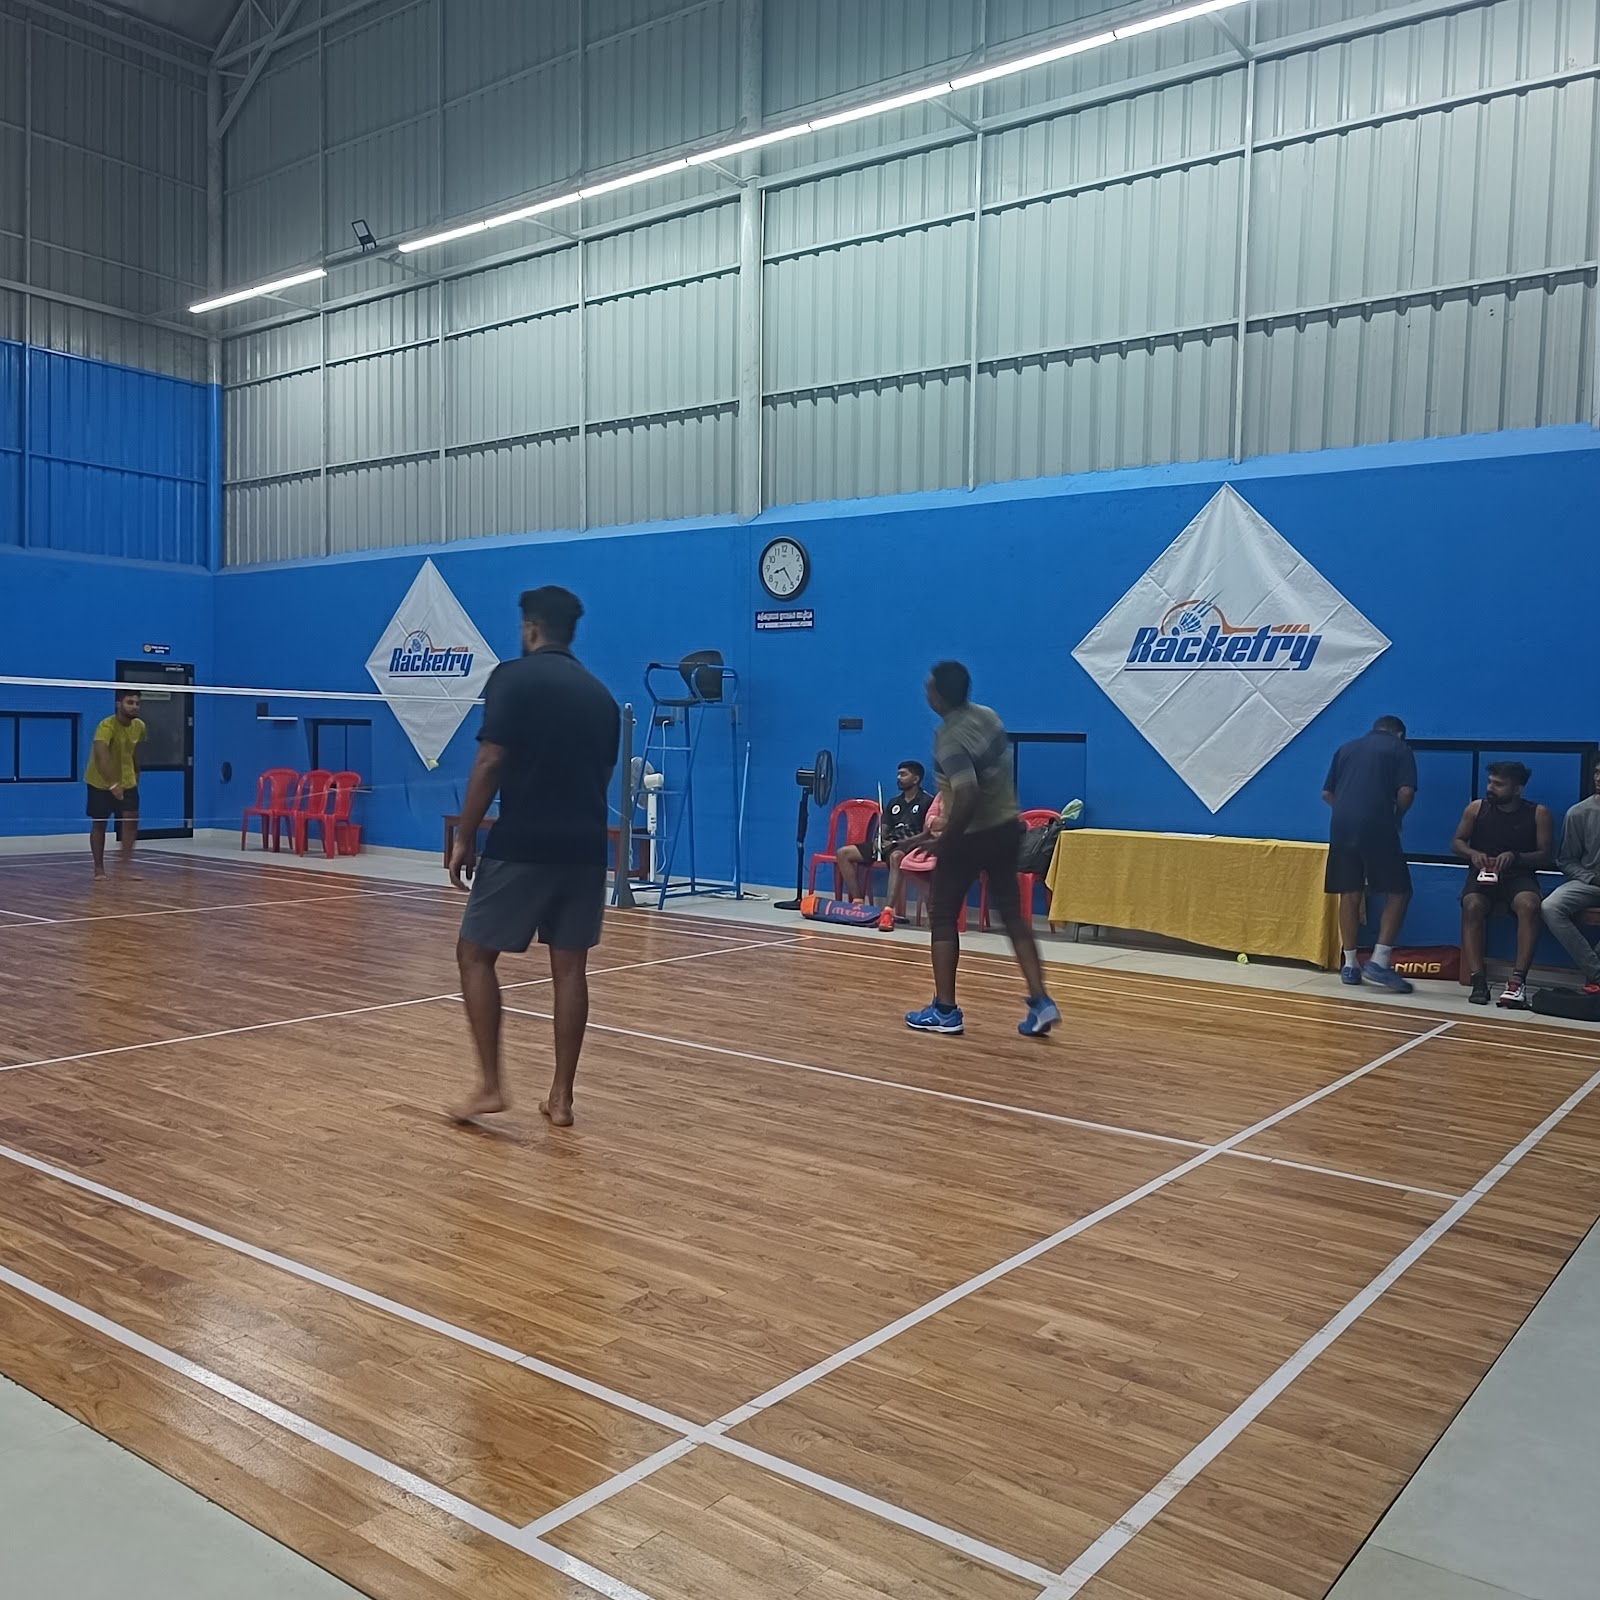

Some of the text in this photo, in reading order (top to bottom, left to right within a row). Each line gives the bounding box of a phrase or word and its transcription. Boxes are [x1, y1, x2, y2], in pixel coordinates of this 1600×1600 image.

[775, 548, 780, 556] 11
[782, 545, 787, 553] 12
[769, 555, 776, 564] 10
[796, 554, 800, 562] 2
[798, 564, 803, 572] 3
[774, 581, 779, 590] 7
[782, 584, 787, 592] 6
[790, 582, 795, 590] 5
[1126, 624, 1323, 671] Racketry
[389, 646, 474, 677] Racketry
